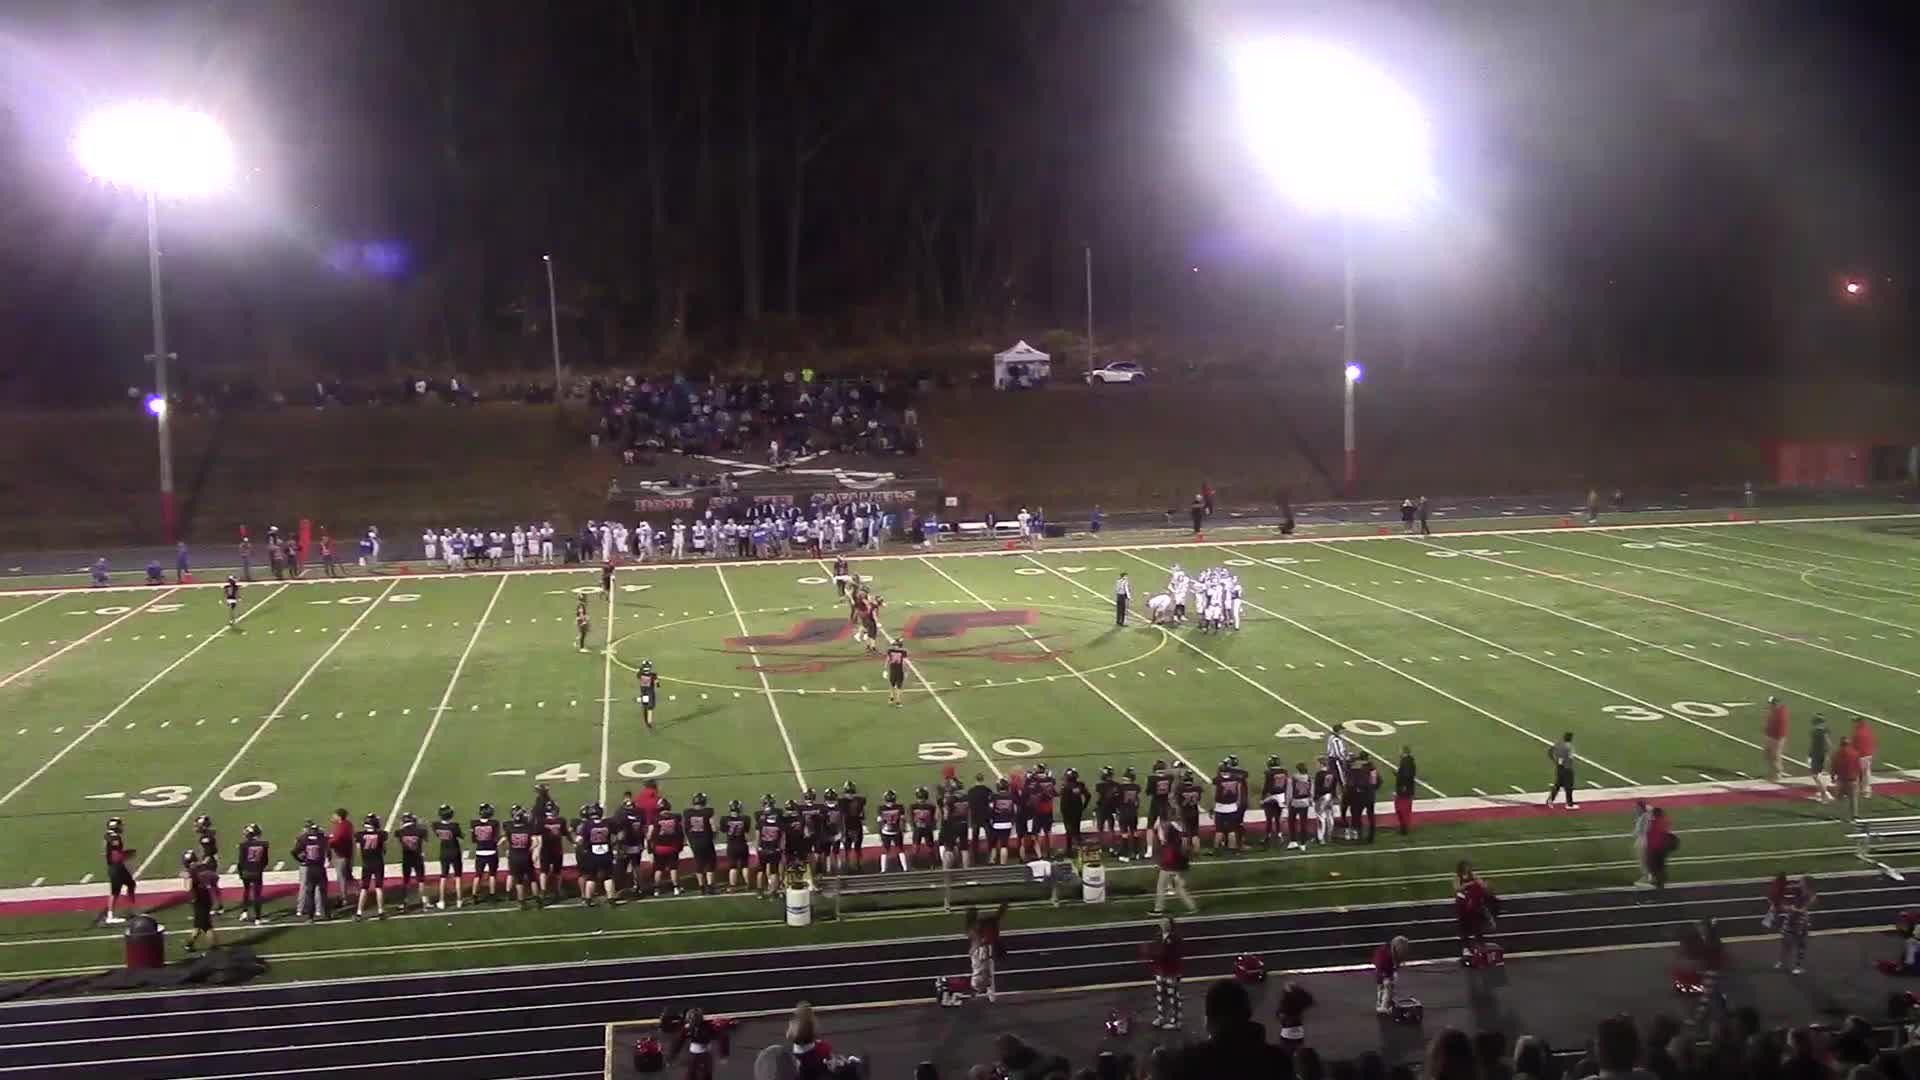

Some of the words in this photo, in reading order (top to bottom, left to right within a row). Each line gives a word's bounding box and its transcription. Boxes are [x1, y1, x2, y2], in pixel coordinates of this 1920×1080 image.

[1601, 701, 1730, 722] 30
[1275, 719, 1397, 742] 40
[917, 739, 1044, 761] 50
[535, 759, 672, 783] 40
[129, 781, 278, 807] 30
